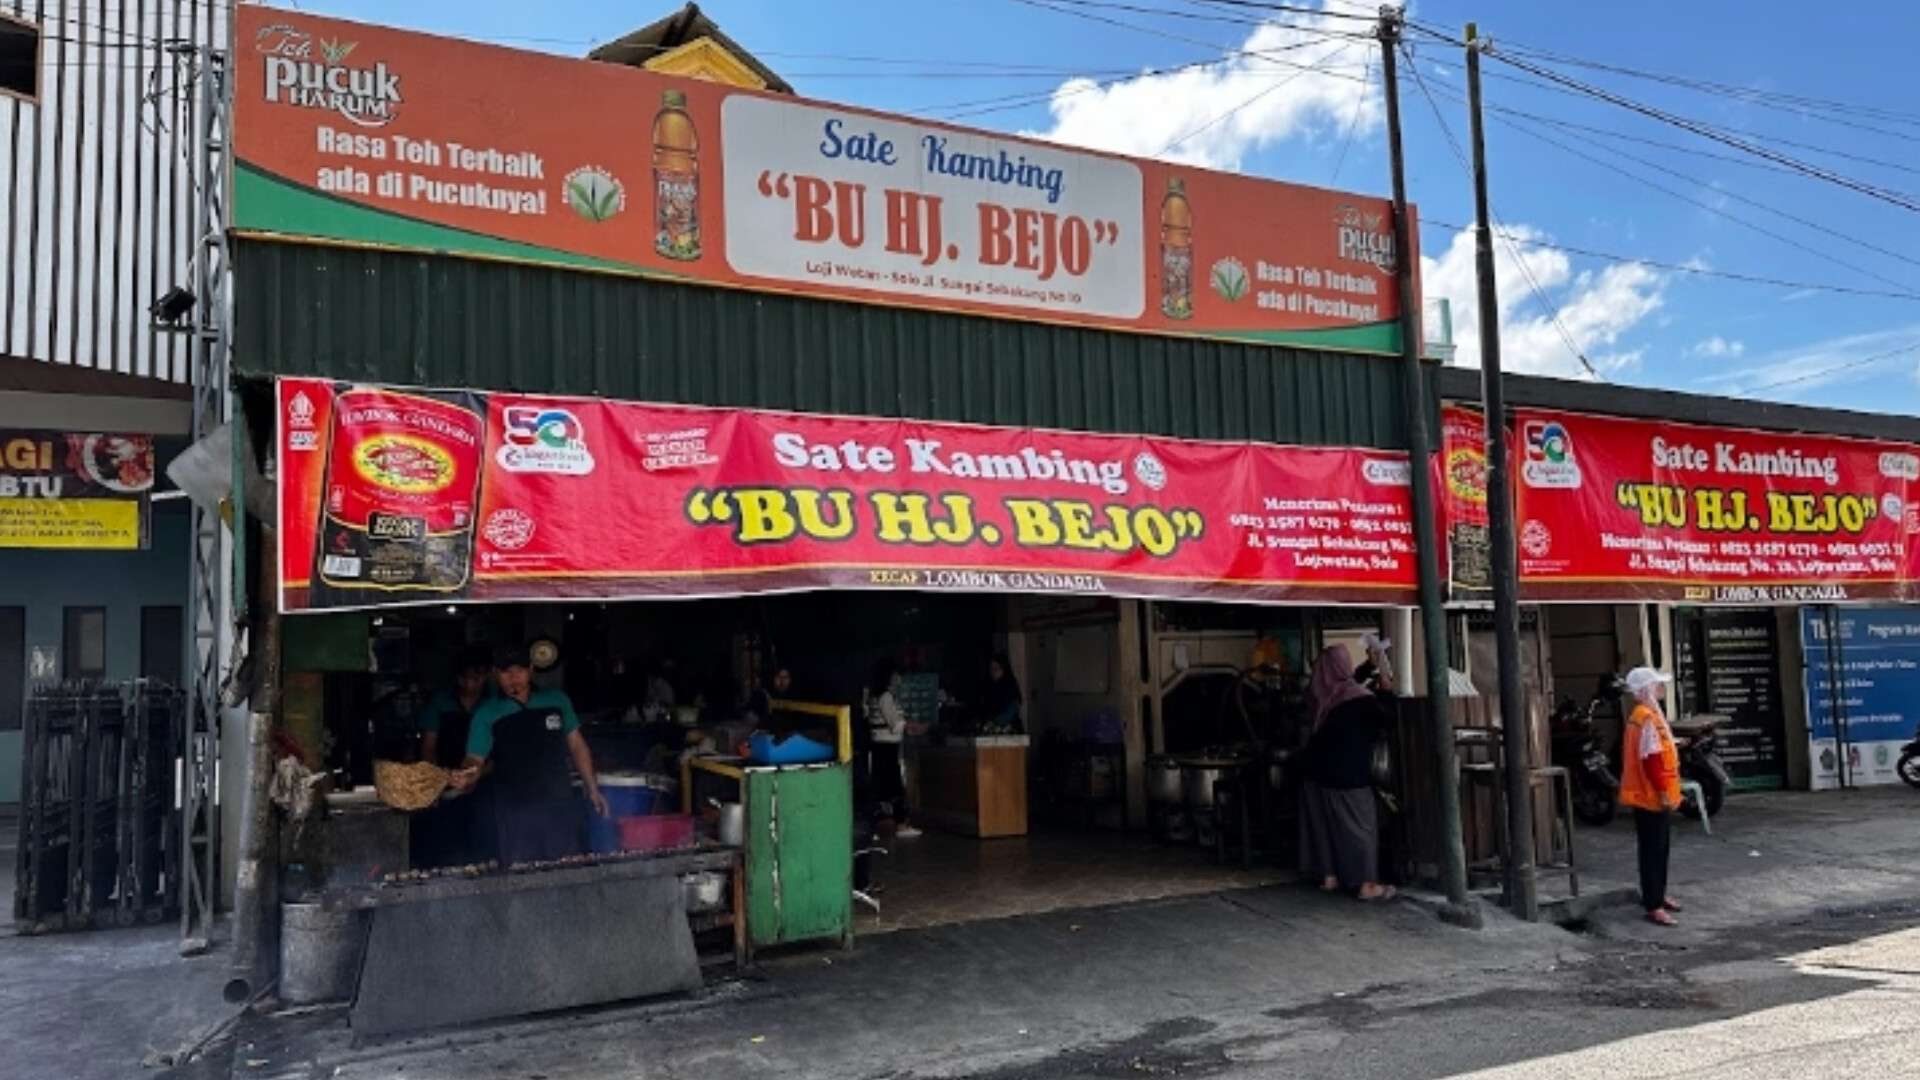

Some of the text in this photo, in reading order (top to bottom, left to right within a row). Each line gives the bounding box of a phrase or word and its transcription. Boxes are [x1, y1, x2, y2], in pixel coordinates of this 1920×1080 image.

[289, 86, 388, 117] HARUM
[317, 126, 544, 180] Rasa Teh Terbaik
[820, 119, 1065, 203] Sate Kambing
[317, 166, 369, 194] ada
[376, 171, 403, 198] di
[409, 174, 546, 215] Pucuknya!
[884, 189, 959, 265] HJ.
[806, 260, 832, 277] Loji
[1257, 259, 1294, 284] Rasa
[1296, 267, 1321, 287] Teh
[1325, 269, 1377, 295] Terbaik
[1257, 290, 1286, 311] ada
[1287, 292, 1302, 312] di
[773, 433, 895, 473] Sate
[905, 438, 1128, 494] Kambing
[1652, 436, 1709, 470] Sate
[1715, 442, 1839, 486] Kambing
[870, 490, 1003, 545] HJ.
[1694, 489, 1760, 532] HJ.
[924, 570, 1006, 588] LOMBOK
[1008, 574, 1106, 592] GANDARIA
[1371, 556, 1399, 570] Solo
